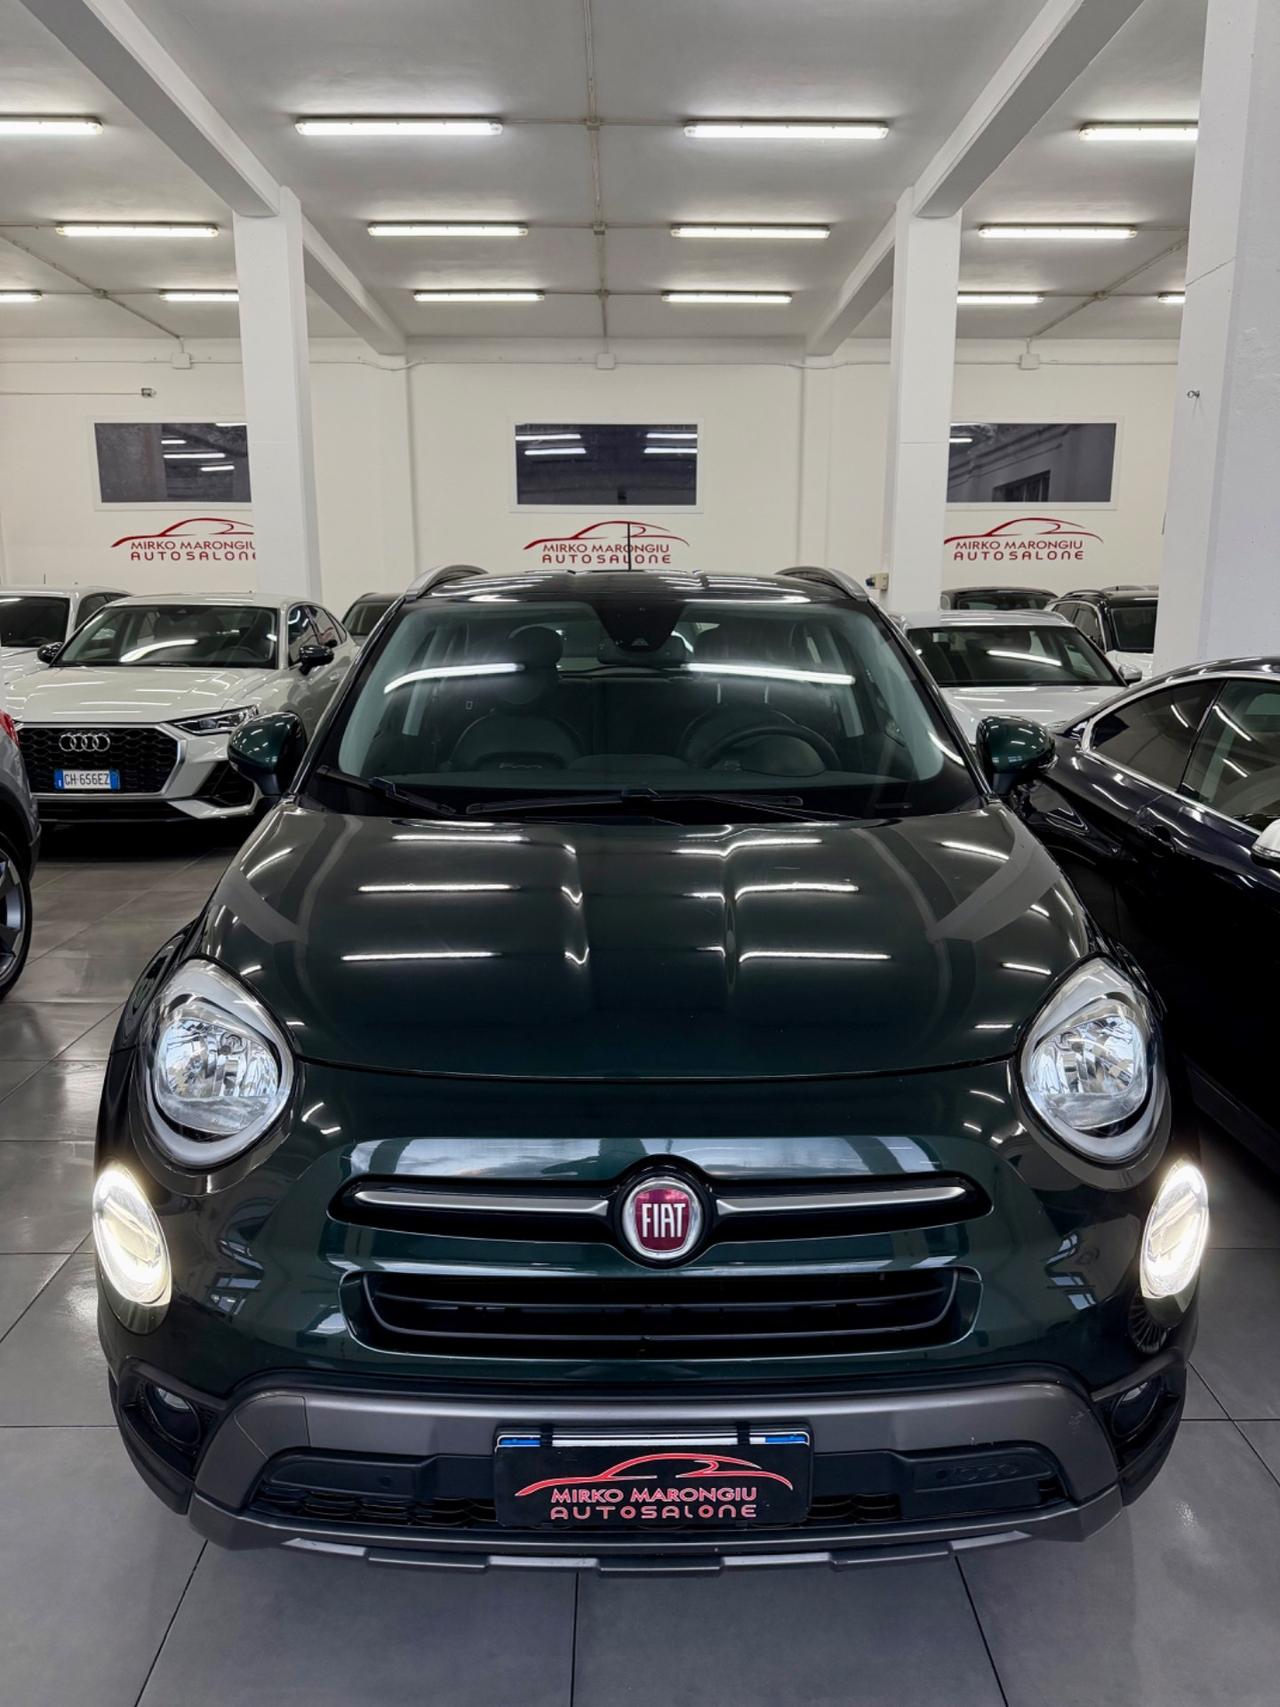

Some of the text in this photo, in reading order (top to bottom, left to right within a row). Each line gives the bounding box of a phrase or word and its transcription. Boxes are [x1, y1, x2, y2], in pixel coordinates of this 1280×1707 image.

[130, 541, 176, 550] MIRKO
[543, 544, 670, 553] MIRKO MARONGIU
[955, 541, 1083, 550] MIRKO MARONGIU
[542, 554, 671, 564] AUTOSALONE
[953, 551, 1084, 561] AUTOSALONE
[641, 1203, 686, 1238] FIAT
[551, 1487, 757, 1503] MIRKO MARONGIU
[551, 1505, 757, 1520] AUTOSALONE
